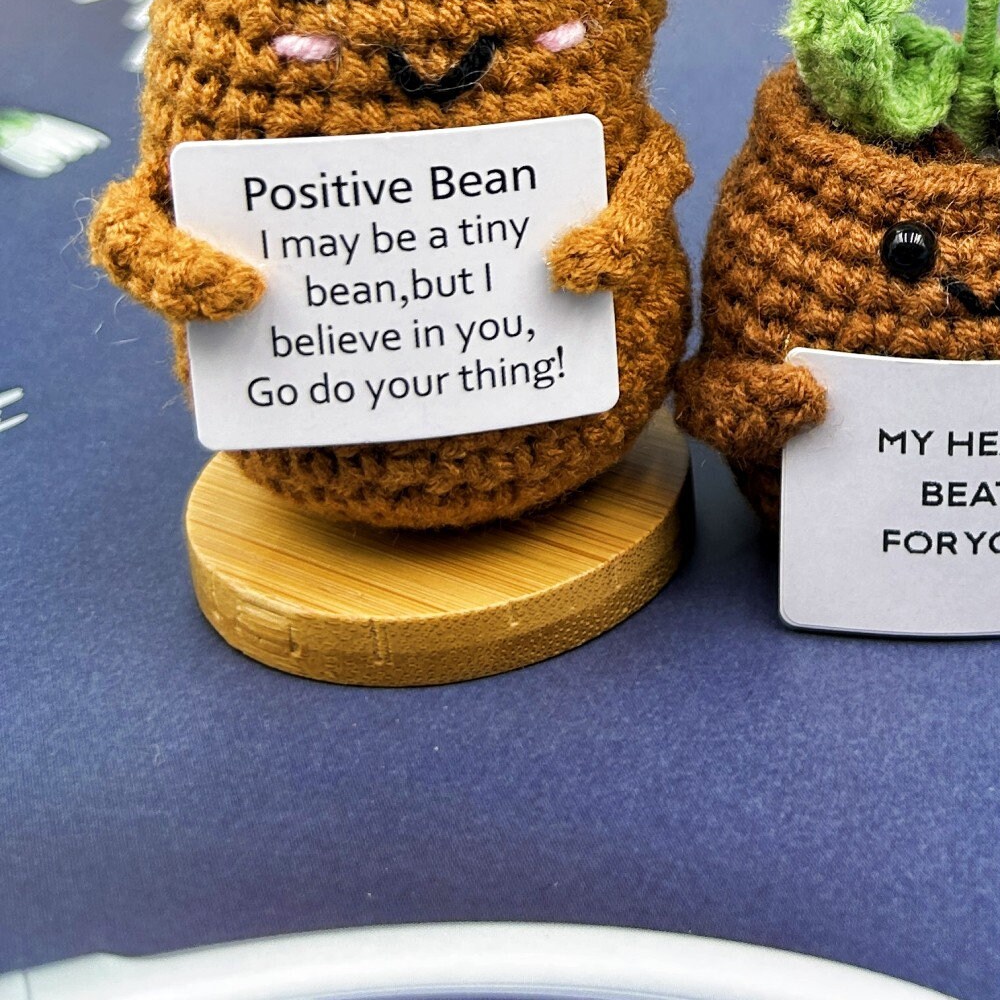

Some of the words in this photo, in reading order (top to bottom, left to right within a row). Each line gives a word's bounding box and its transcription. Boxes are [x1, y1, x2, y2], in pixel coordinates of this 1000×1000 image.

[244, 170, 413, 212] Positive
[430, 165, 536, 200] Bean
[261, 230, 269, 259] I
[282, 233, 360, 265] may
[372, 221, 416, 254] be
[429, 227, 448, 249] a
[458, 214, 530, 249] tiny
[485, 262, 492, 292] I
[271, 323, 401, 358] believe
[413, 319, 444, 348] in
[455, 315, 535, 354] you,
[247, 376, 298, 407] Go
[309, 372, 355, 405] do
[365, 372, 450, 410] your
[458, 345, 565, 392] thing!
[878, 428, 934, 456] MY
